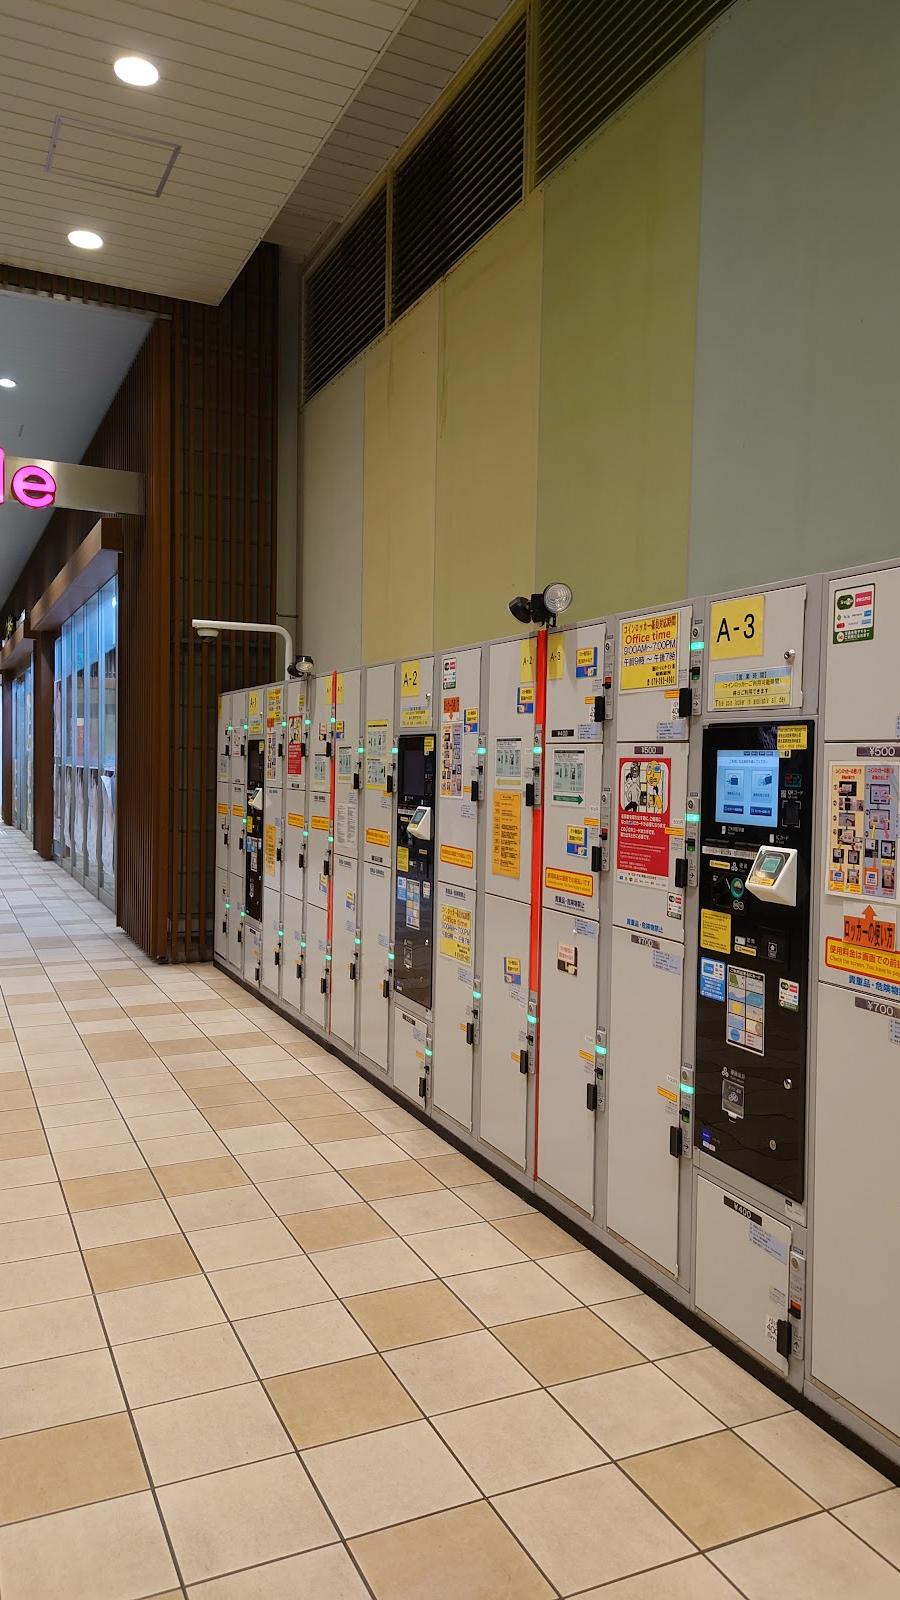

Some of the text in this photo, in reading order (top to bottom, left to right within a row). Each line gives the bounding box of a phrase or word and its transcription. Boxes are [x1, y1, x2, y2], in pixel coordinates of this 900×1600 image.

[716, 613, 755, 643] A-3
[625, 630, 671, 645] Office time
[550, 651, 561, 661] A-3
[402, 670, 418, 687] A-2
[640, 746, 657, 755] ¥500
[869, 746, 896, 757] ¥500
[844, 919, 893, 949] ロッカーの使い方
[848, 974, 900, 996] 貴重品・危険物
[867, 999, 894, 1016] ¥700
[733, 1202, 752, 1219] ¥400
